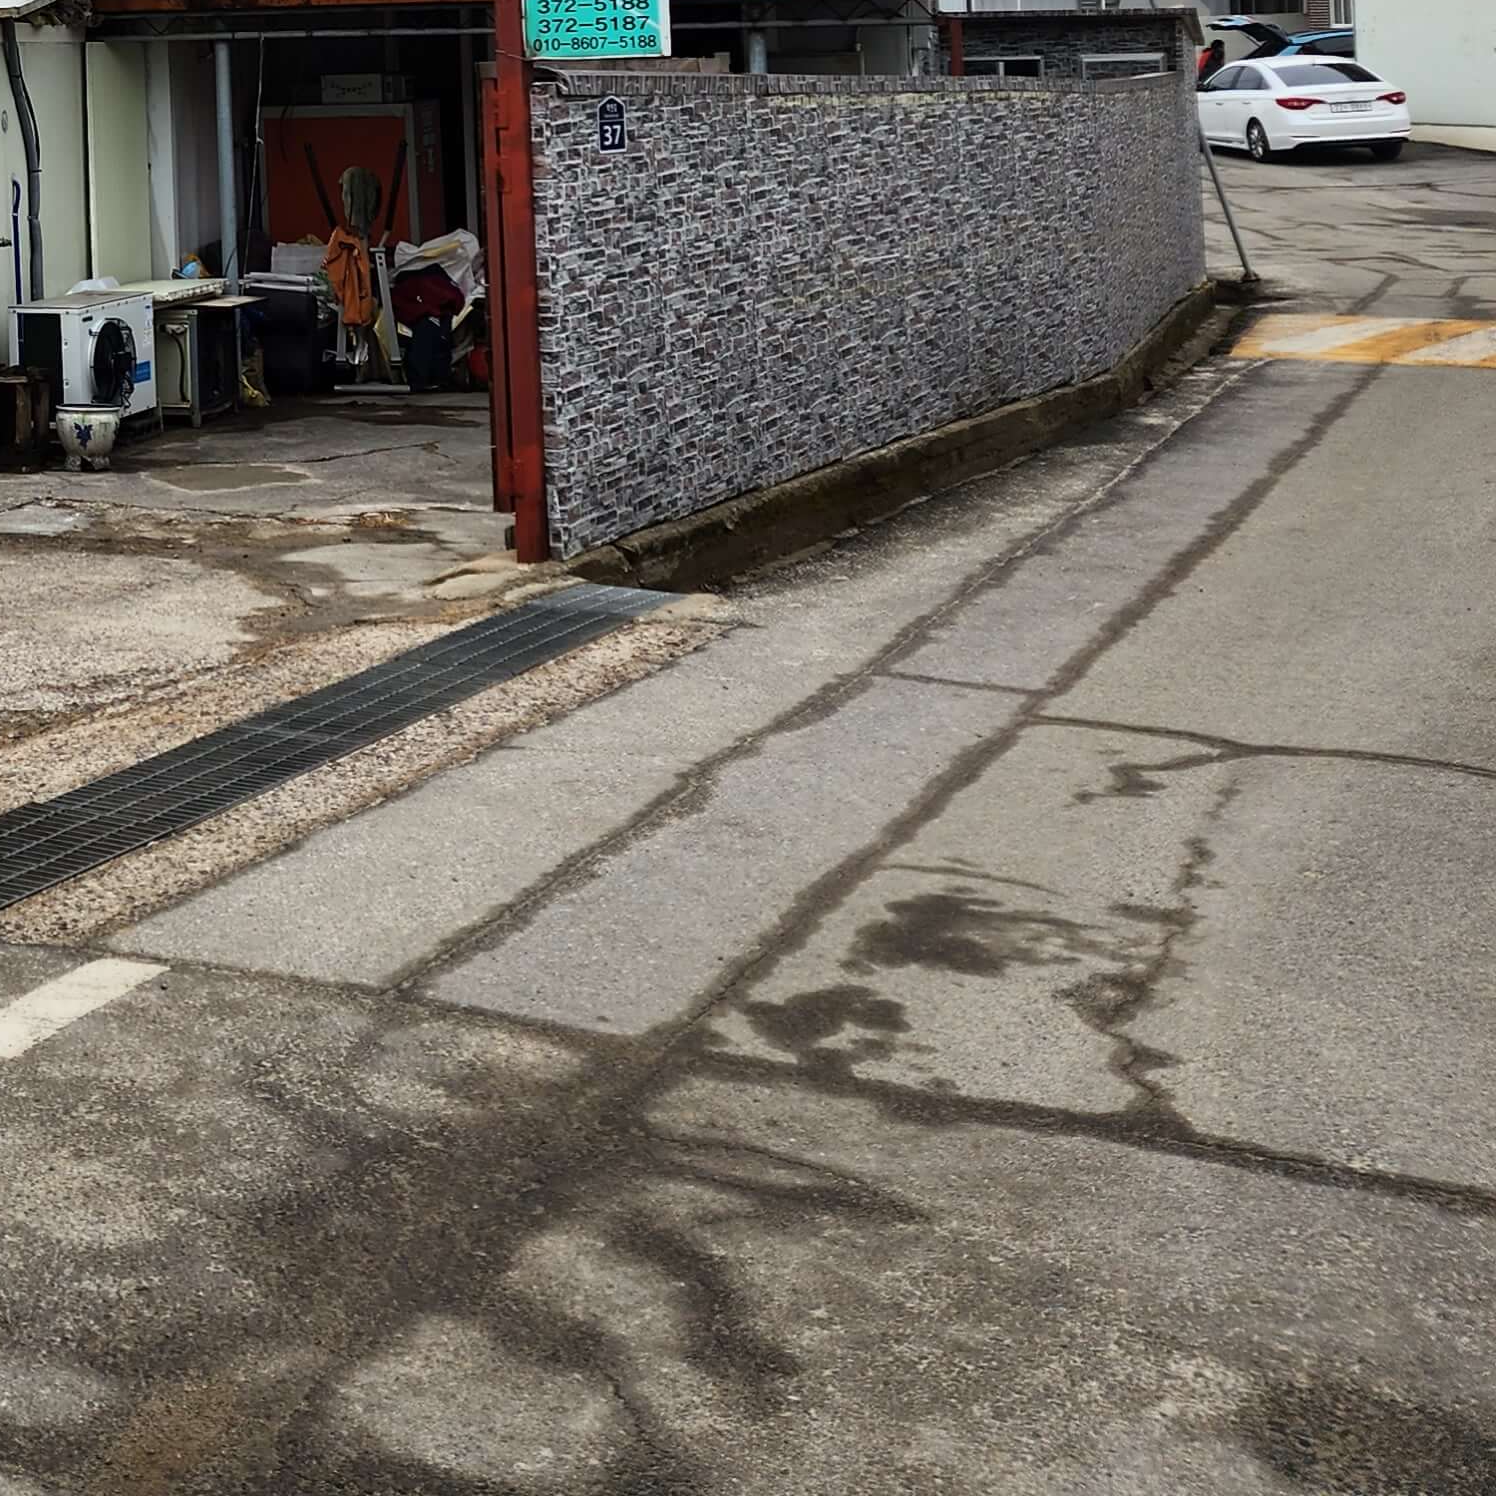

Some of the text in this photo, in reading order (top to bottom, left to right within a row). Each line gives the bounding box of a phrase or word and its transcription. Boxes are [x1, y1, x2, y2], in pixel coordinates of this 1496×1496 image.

[537, 15, 650, 34] 372-5187
[533, 34, 656, 51] 010-8607-5188
[603, 125, 621, 145] 37
